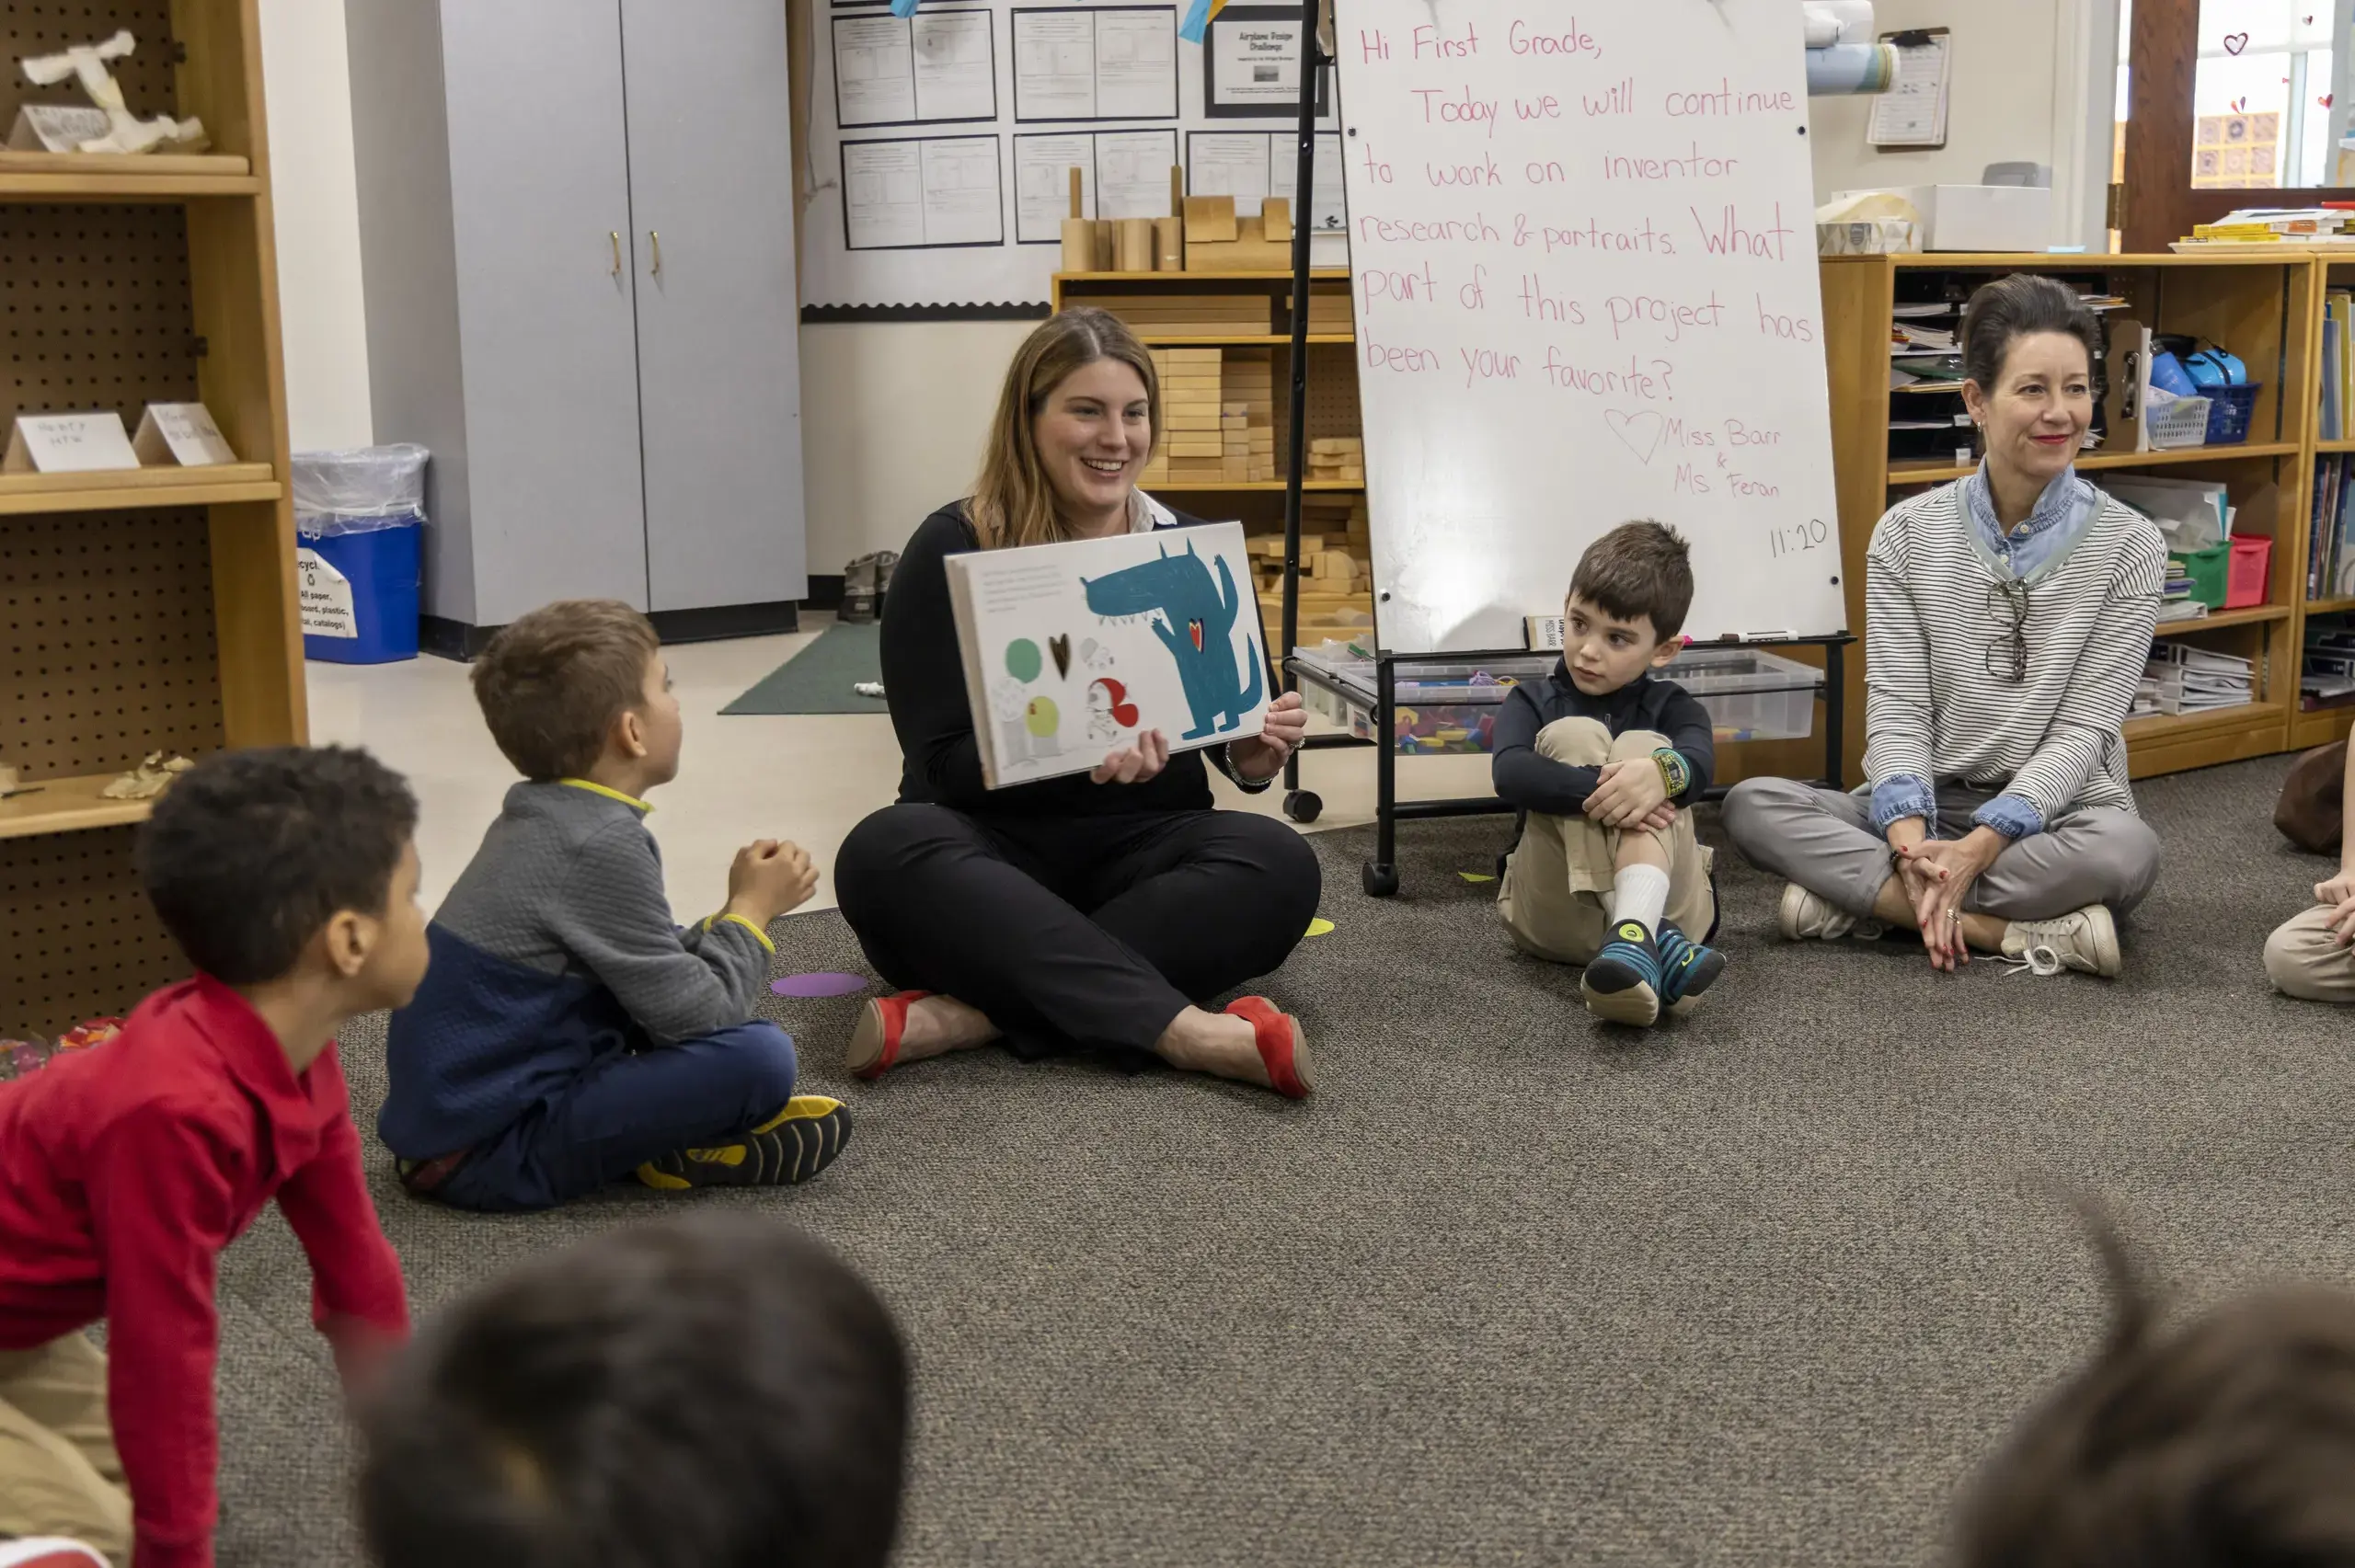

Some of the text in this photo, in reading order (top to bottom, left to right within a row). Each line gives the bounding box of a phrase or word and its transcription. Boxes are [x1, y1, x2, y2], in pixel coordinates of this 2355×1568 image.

[1361, 16, 1602, 64] Hi First Grade,
[1410, 76, 1796, 139] Today we will continue
[1363, 141, 1739, 187] to work on inventor
[1360, 200, 1795, 261] research & portraits. What
[1361, 261, 1813, 342] part of this project has
[1363, 326, 1673, 401] been your favorite?
[1664, 418, 1781, 448] Miss Barr
[1717, 451, 1728, 469] &
[1726, 472, 1781, 498] Feran
[1771, 519, 1827, 558] 11:20
[310, 591, 333, 601] paper,
[322, 607, 350, 617] plastic,
[314, 620, 346, 632] catalogs)
